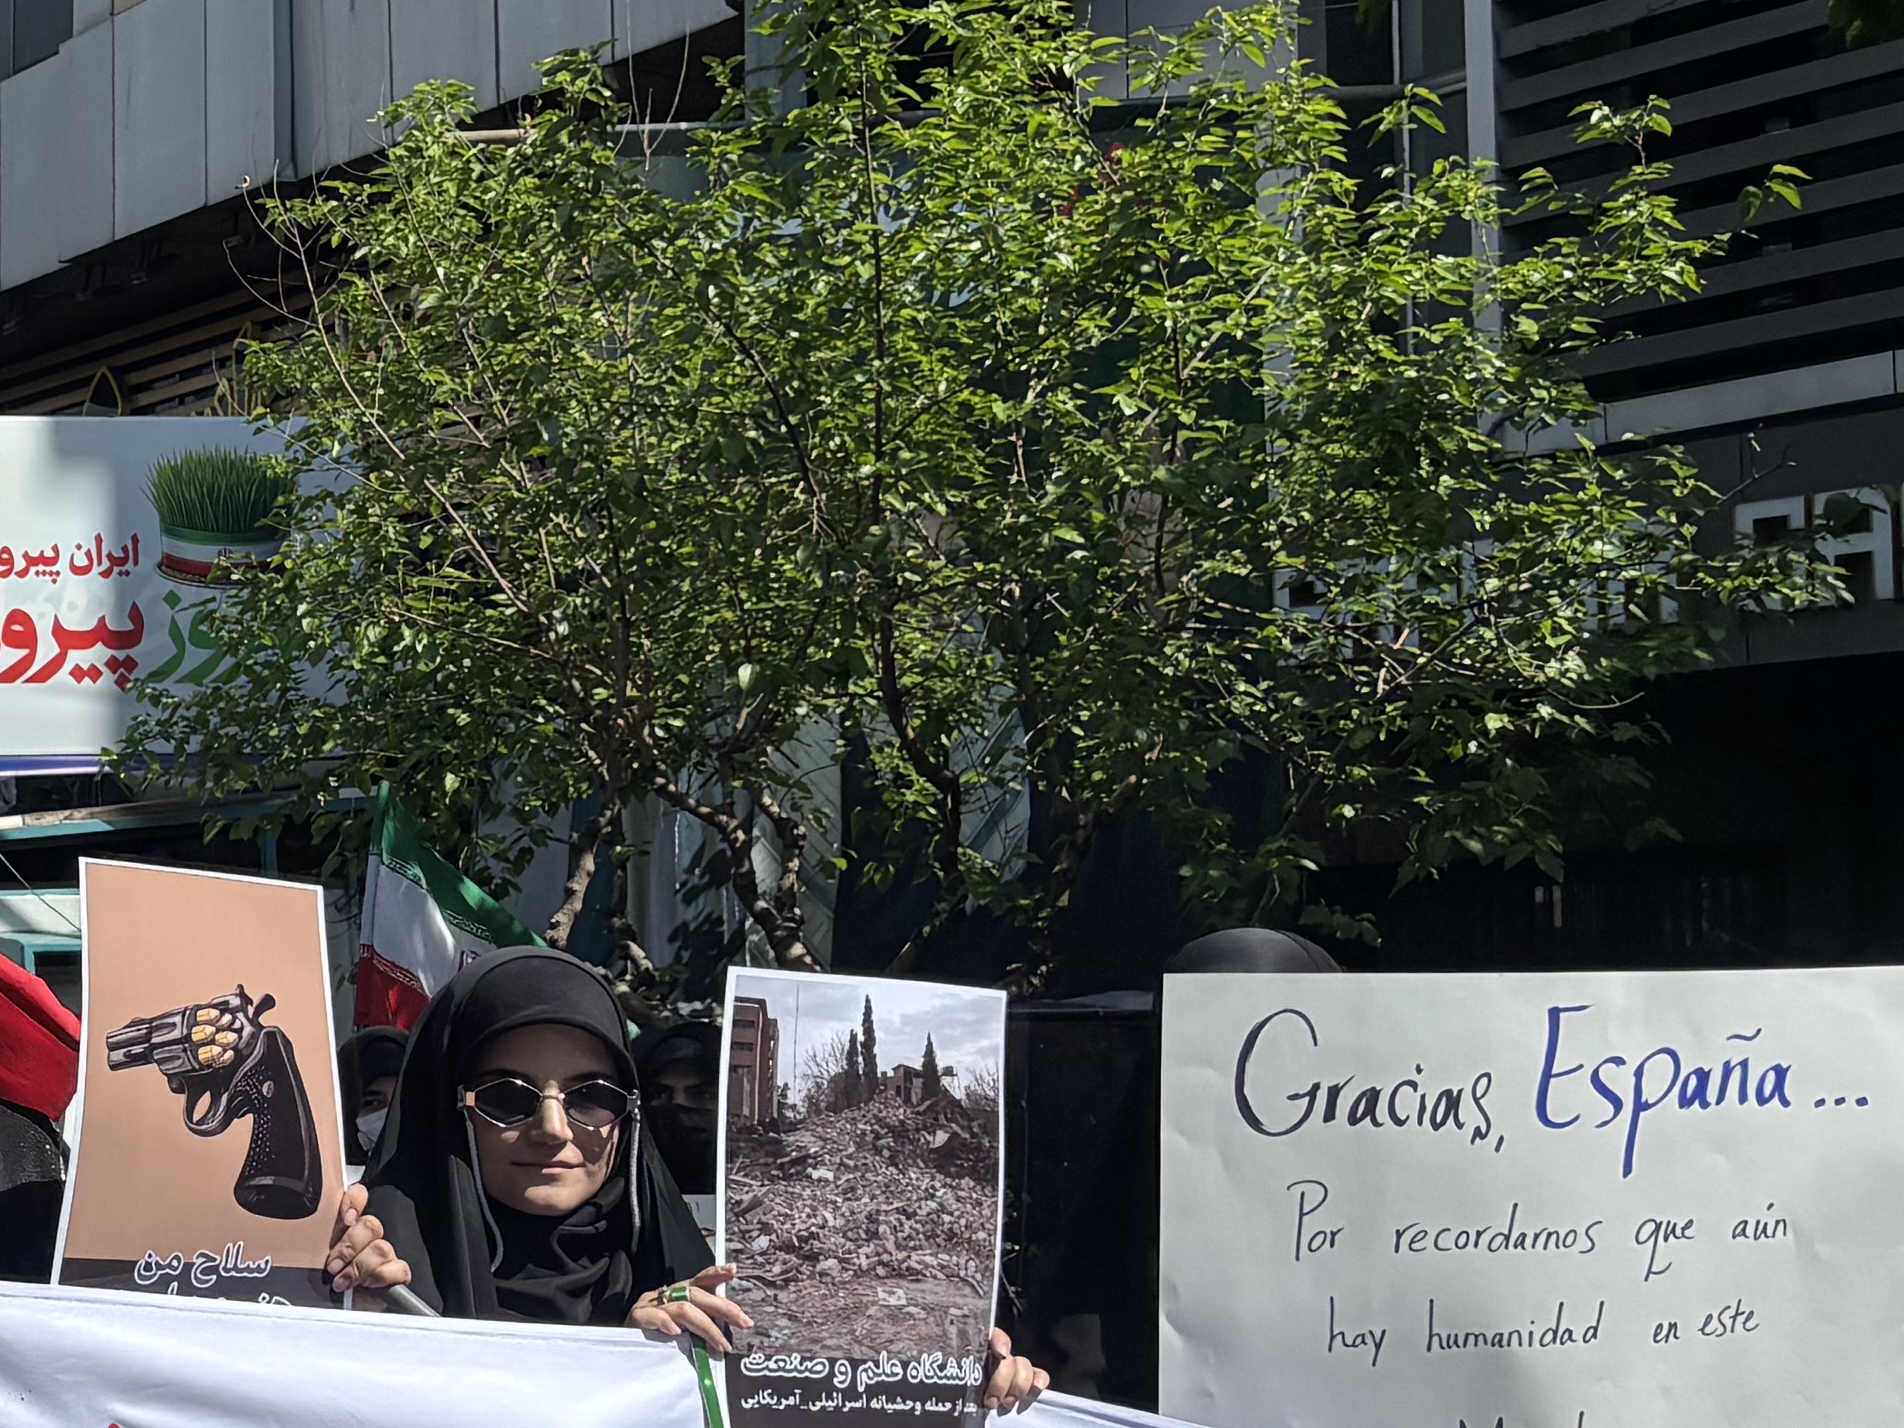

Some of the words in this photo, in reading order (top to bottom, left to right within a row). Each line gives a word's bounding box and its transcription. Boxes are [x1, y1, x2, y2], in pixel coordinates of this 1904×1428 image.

[69, 532, 140, 578] ایران
[1234, 1008, 1505, 1153] Gracias,
[1287, 1179, 1343, 1261] Por
[1393, 1202, 1604, 1255] recordarnos
[1634, 1212, 1695, 1281] que
[1731, 1203, 1788, 1241] aún
[134, 1247, 183, 1285] من
[191, 1241, 272, 1287] سلاح
[1328, 1295, 1387, 1367] hay
[1426, 1299, 1604, 1353] humanidad
[1652, 1320, 1681, 1345] en
[1697, 1298, 1760, 1335] este
[740, 1352, 829, 1378] صنعت
[833, 1359, 852, 1388] و
[857, 1350, 904, 1392] علم
[907, 1351, 983, 1387] دانشگاه
[870, 1394, 922, 1416] وحشیانه
[924, 1396, 953, 1412] حمله
